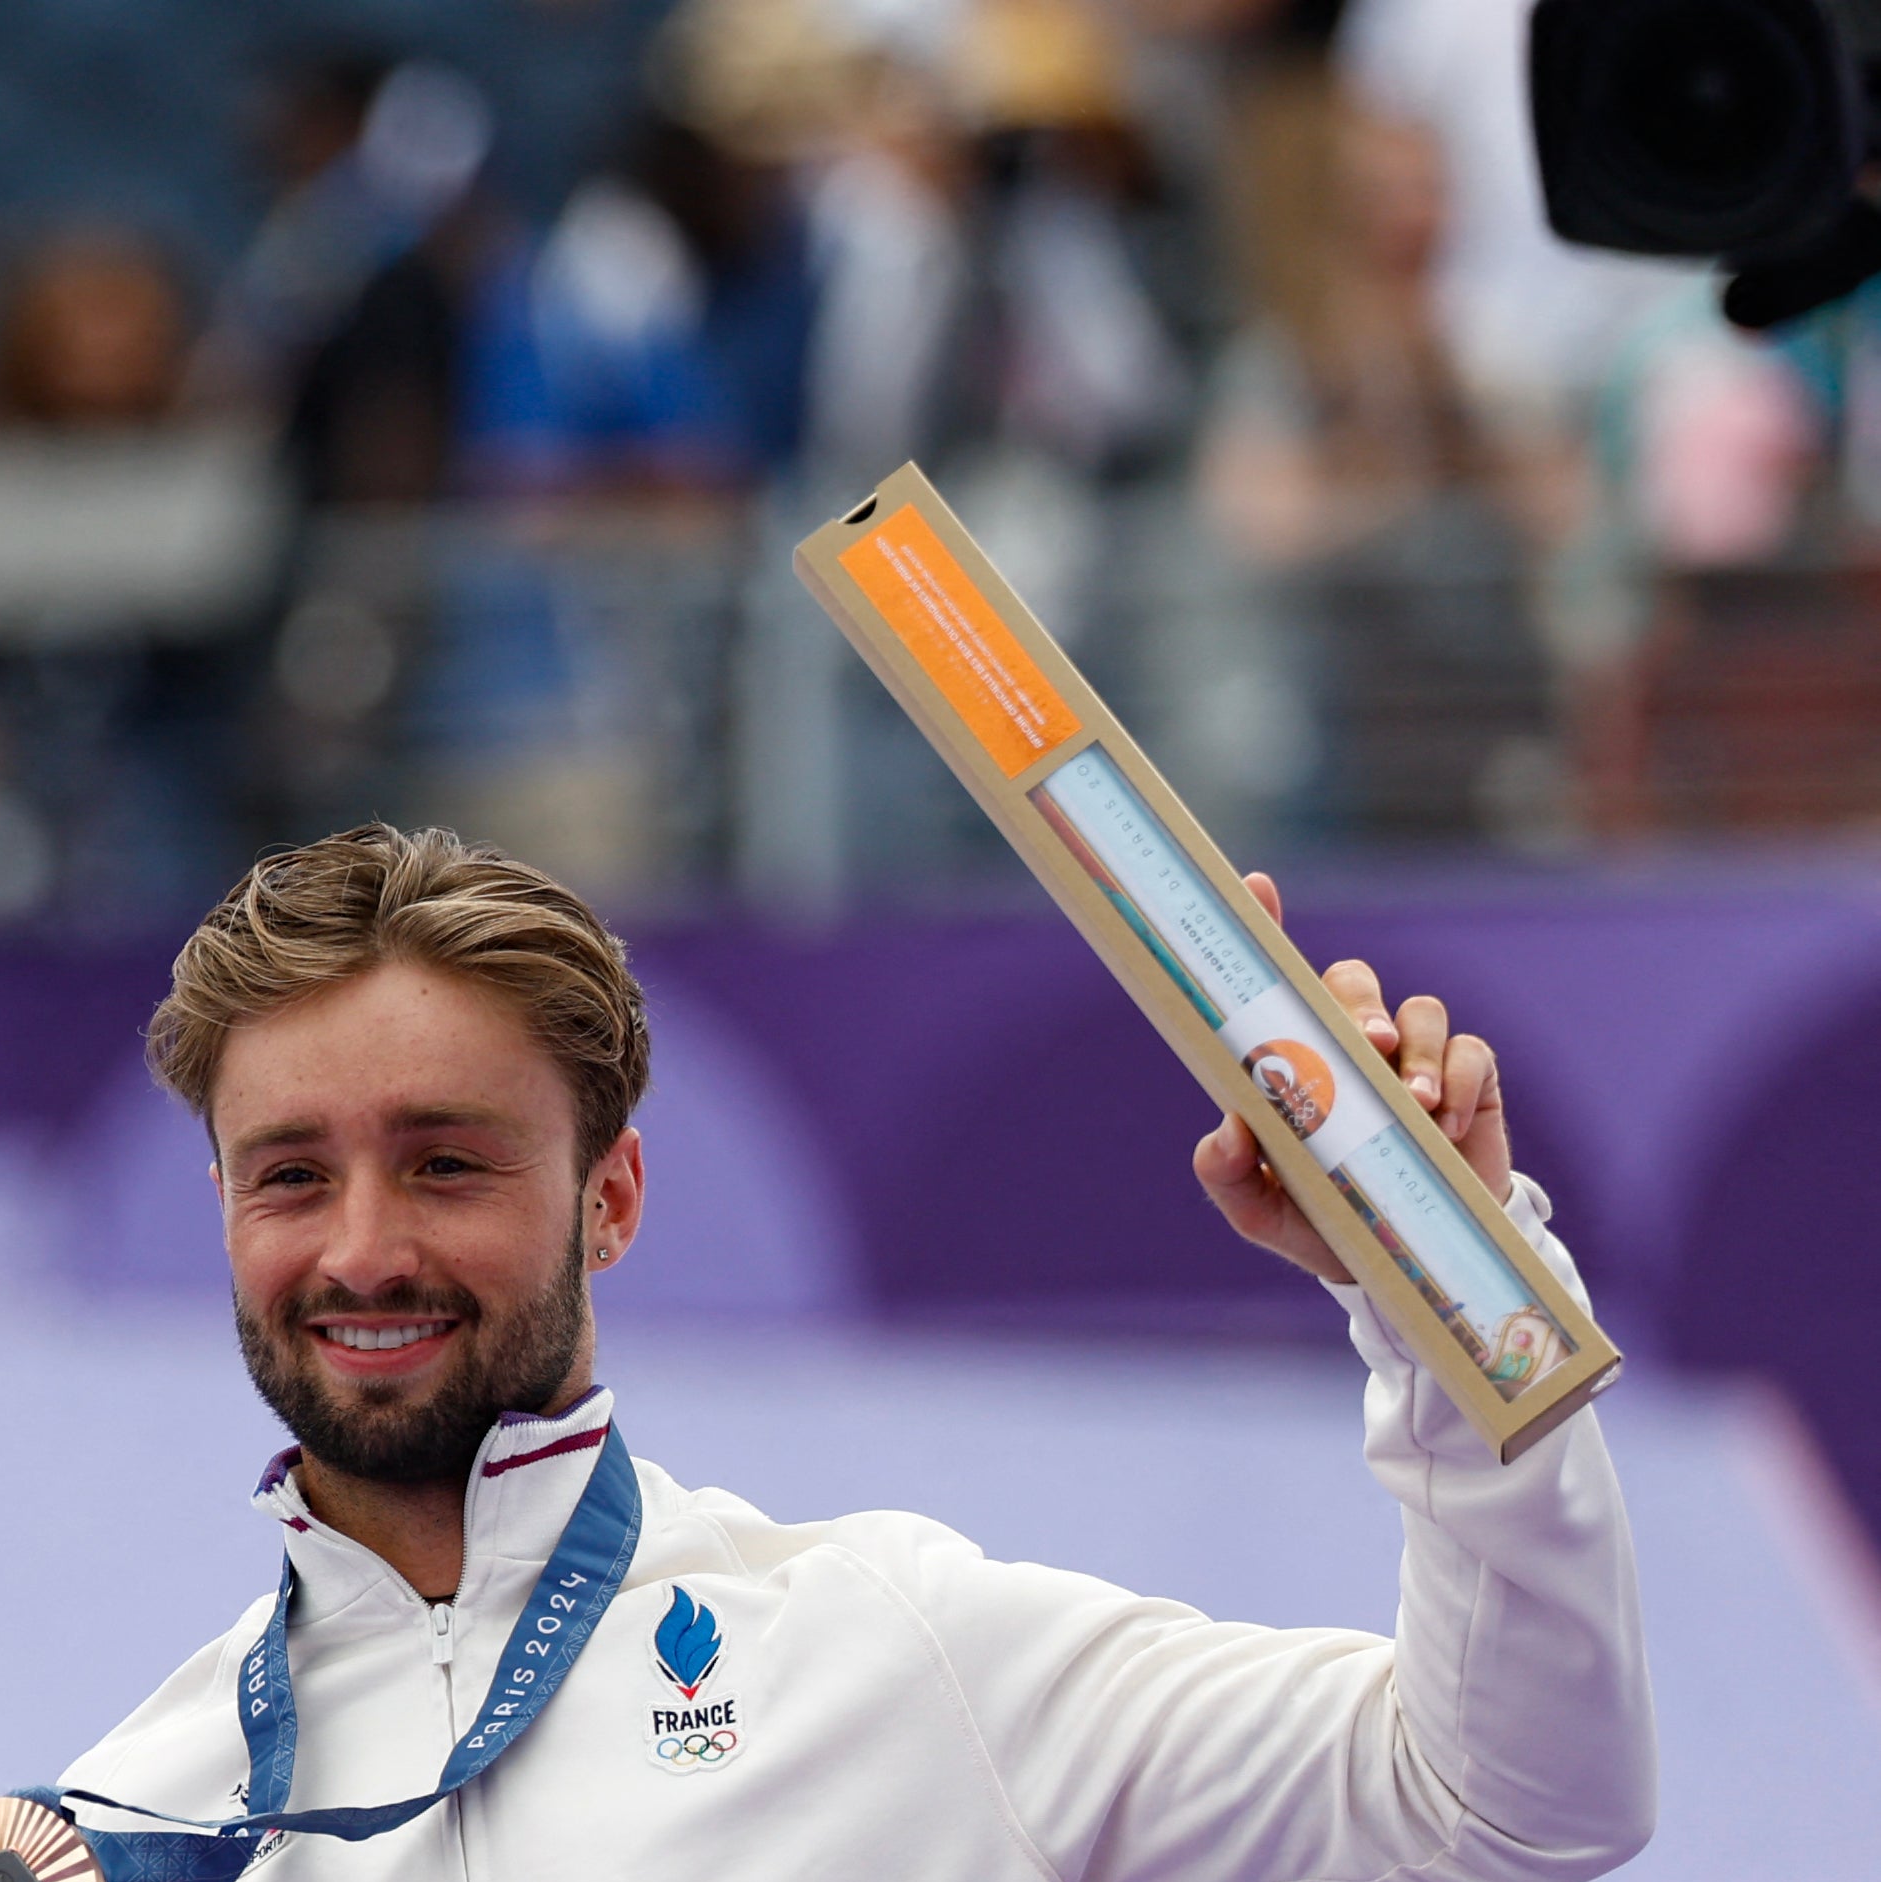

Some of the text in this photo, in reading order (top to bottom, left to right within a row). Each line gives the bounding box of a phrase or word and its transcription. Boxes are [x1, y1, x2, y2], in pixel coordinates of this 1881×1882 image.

[1075, 762, 1099, 790] 20
[1102, 797, 1153, 858] PARIS
[1156, 866, 1180, 891] DE
[1183, 898, 1264, 998] LYMPIADE
[525, 1572, 588, 1656] 2024
[250, 1637, 269, 1719] PARi
[652, 1699, 736, 1735] FRANCE
